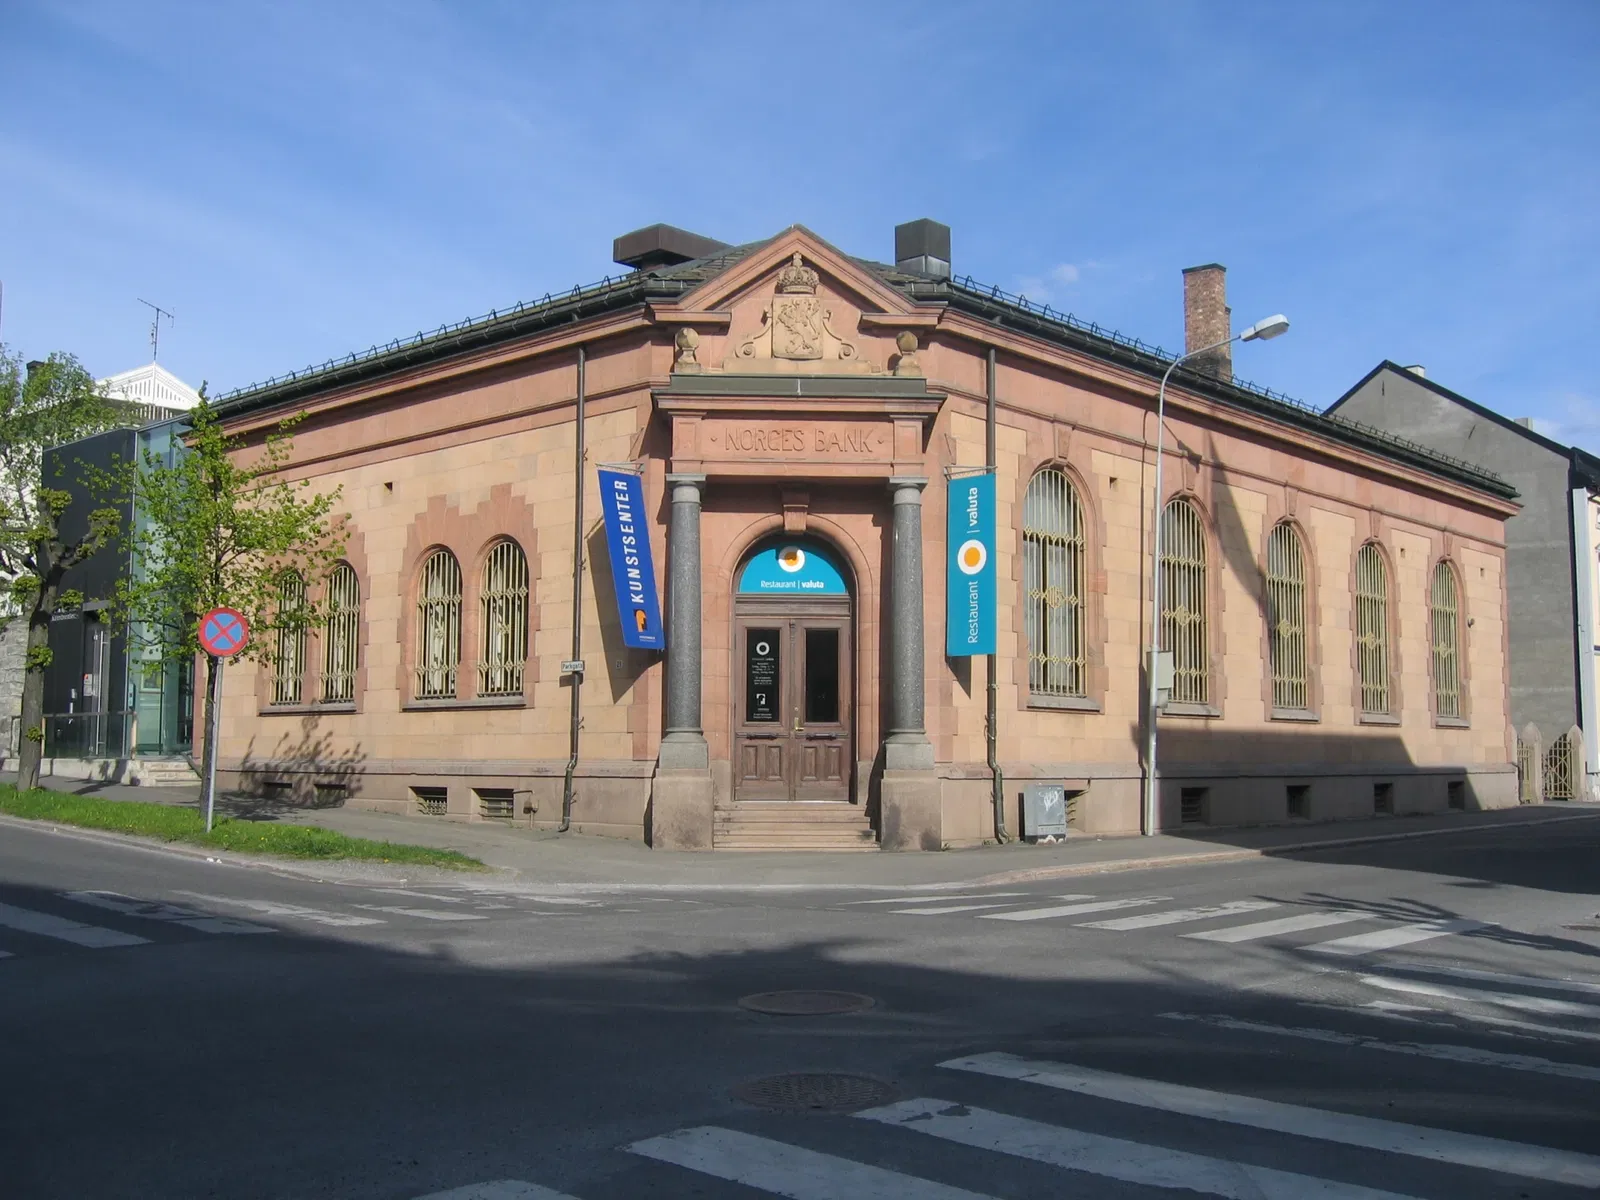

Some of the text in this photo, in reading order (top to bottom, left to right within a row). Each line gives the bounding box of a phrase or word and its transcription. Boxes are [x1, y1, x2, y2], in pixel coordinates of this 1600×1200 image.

[725, 428, 873, 453] NORGES BANK
[614, 480, 645, 604] KUNSTSENTER
[966, 486, 979, 644] Restaurant valuta
[760, 580, 825, 589] Restaurant valuta
